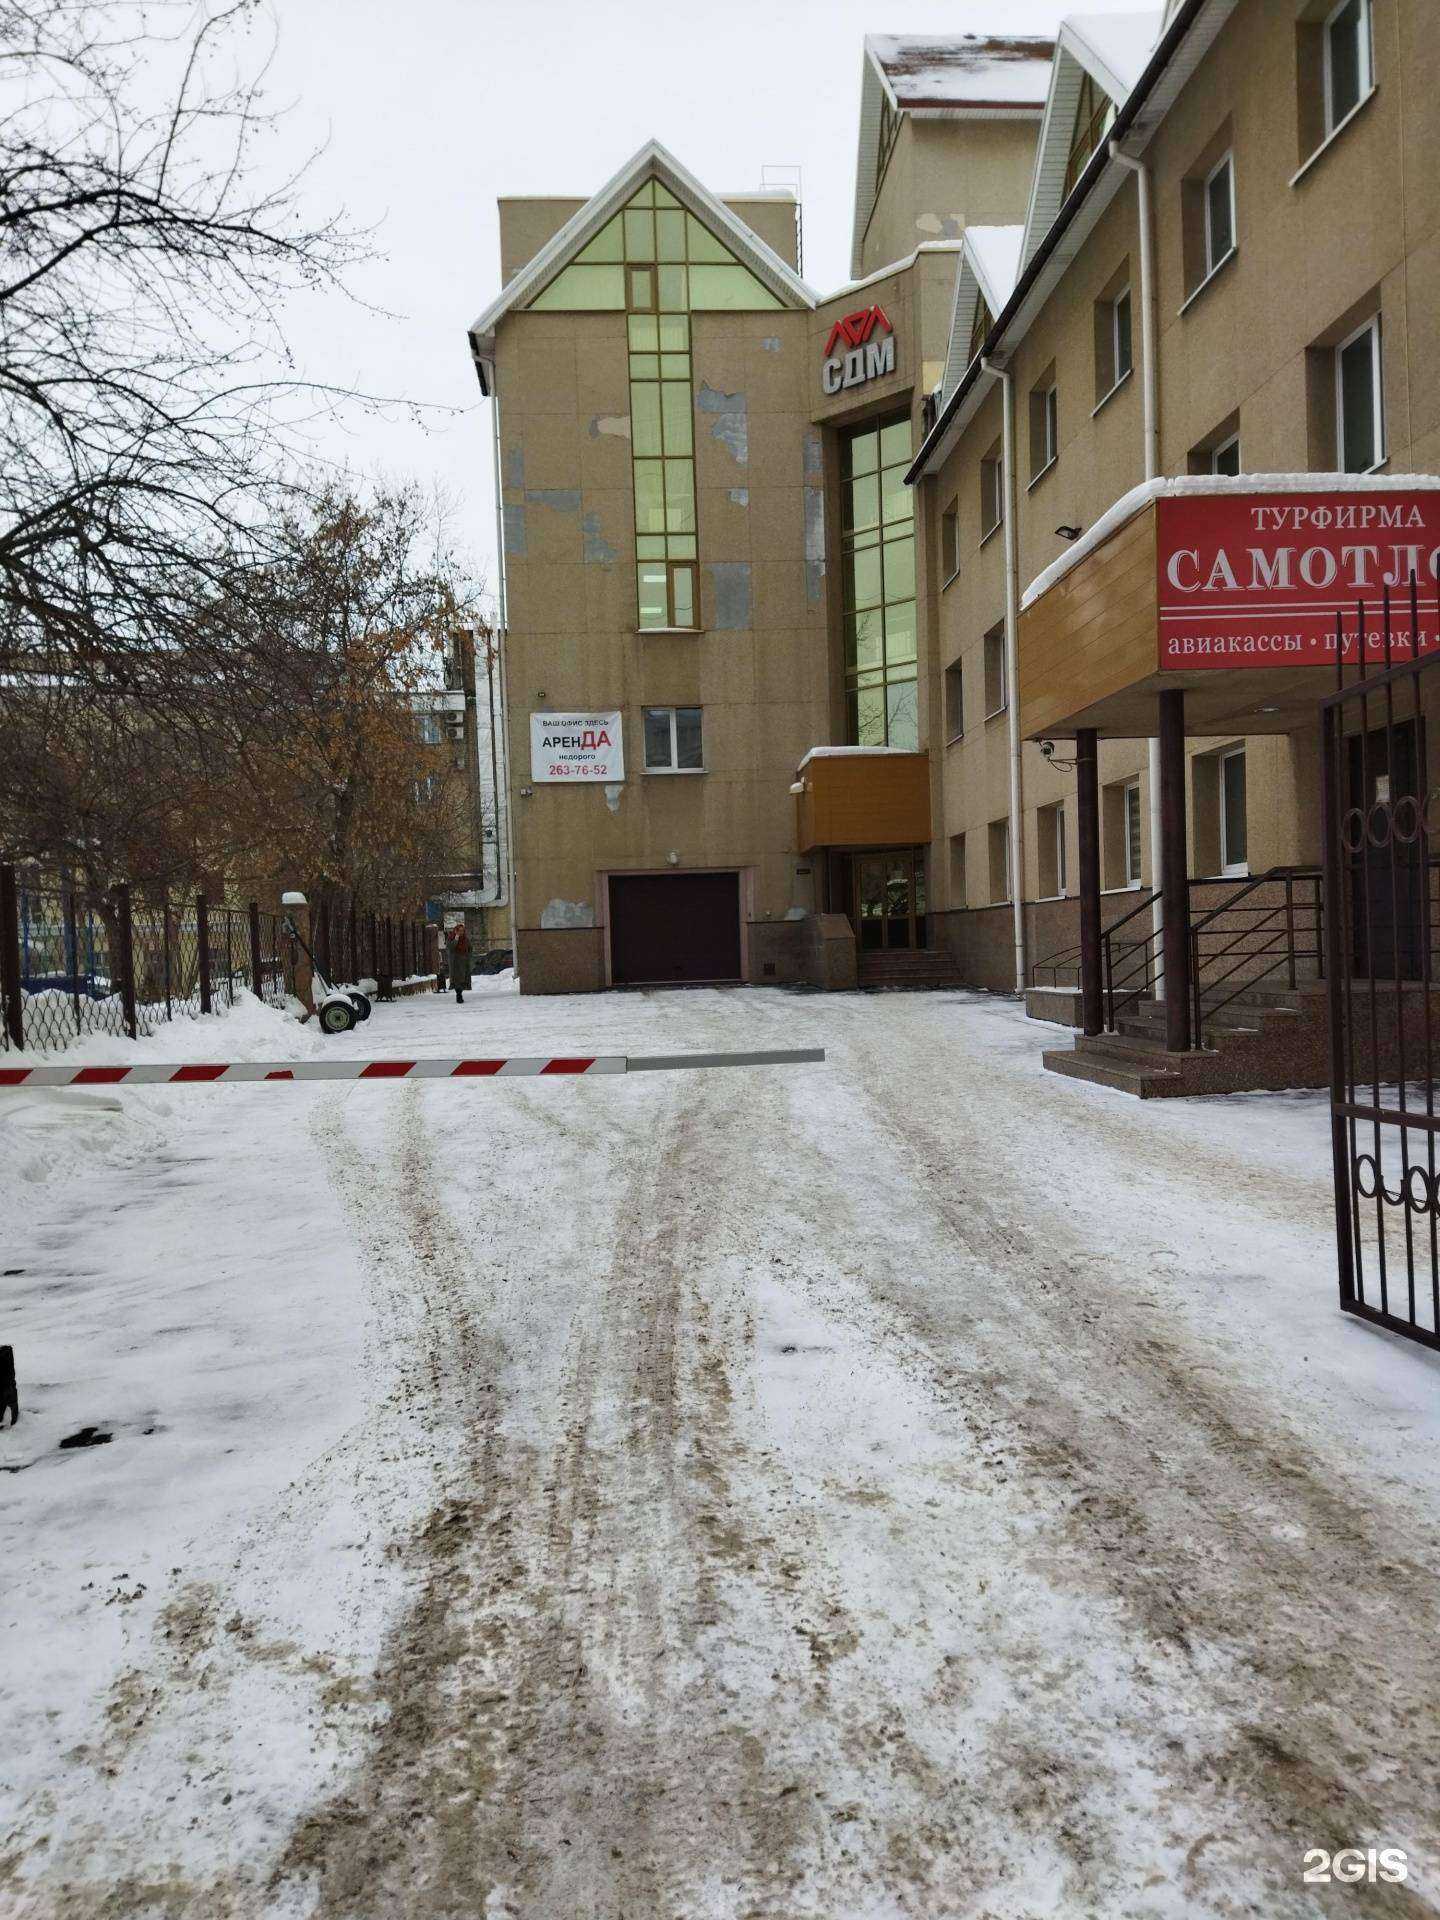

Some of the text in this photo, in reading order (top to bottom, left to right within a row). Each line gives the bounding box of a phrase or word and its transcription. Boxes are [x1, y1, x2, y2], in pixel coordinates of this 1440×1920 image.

[822, 336, 895, 394] СДМ
[1250, 504, 1426, 531] ТУРФИРМА
[1167, 544, 1440, 593] САМОТЛ
[1168, 632, 1303, 655] авиакассы
[586, 719, 609, 727] ЗДЕСЬ
[542, 730, 612, 750] АРЕНДА
[549, 764, 608, 776] 263-76-52
